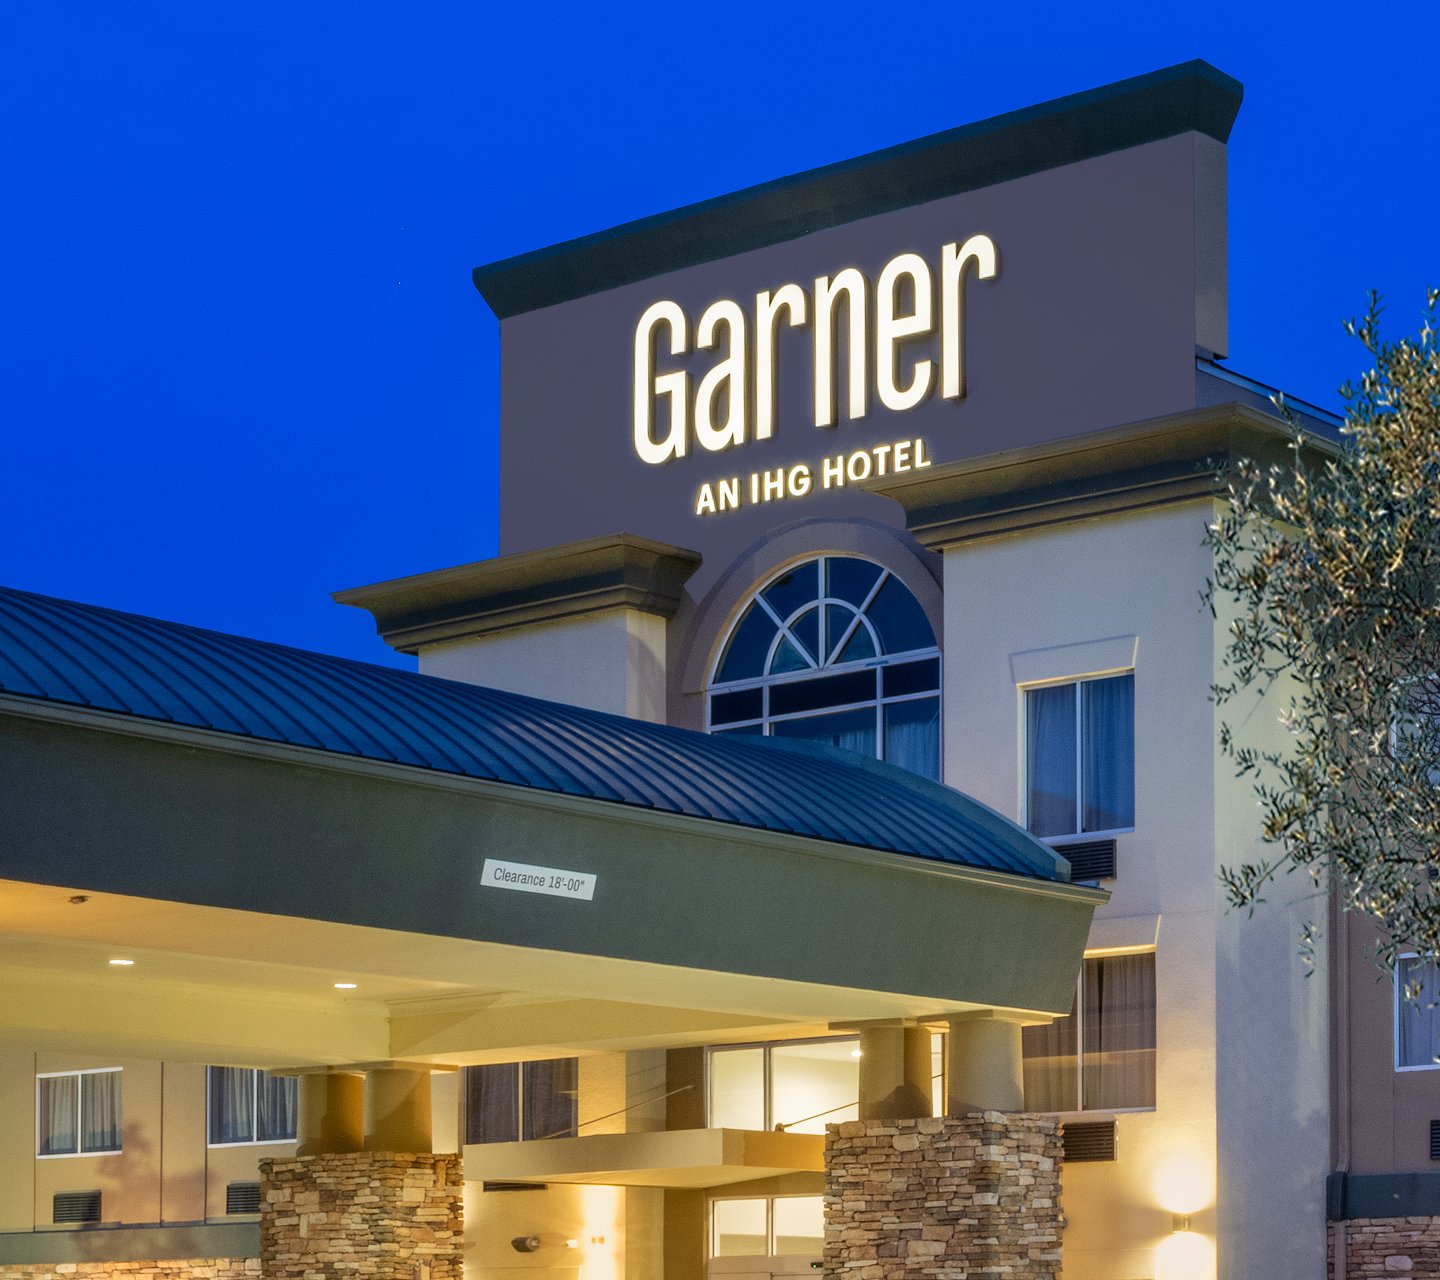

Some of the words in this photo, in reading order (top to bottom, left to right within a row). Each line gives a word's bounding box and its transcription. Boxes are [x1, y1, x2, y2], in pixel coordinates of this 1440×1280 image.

[634, 234, 996, 464] Garner
[696, 477, 739, 515] AN
[751, 464, 810, 504] IHG
[823, 438, 931, 489] HOTEL
[494, 867, 545, 887] Clearance
